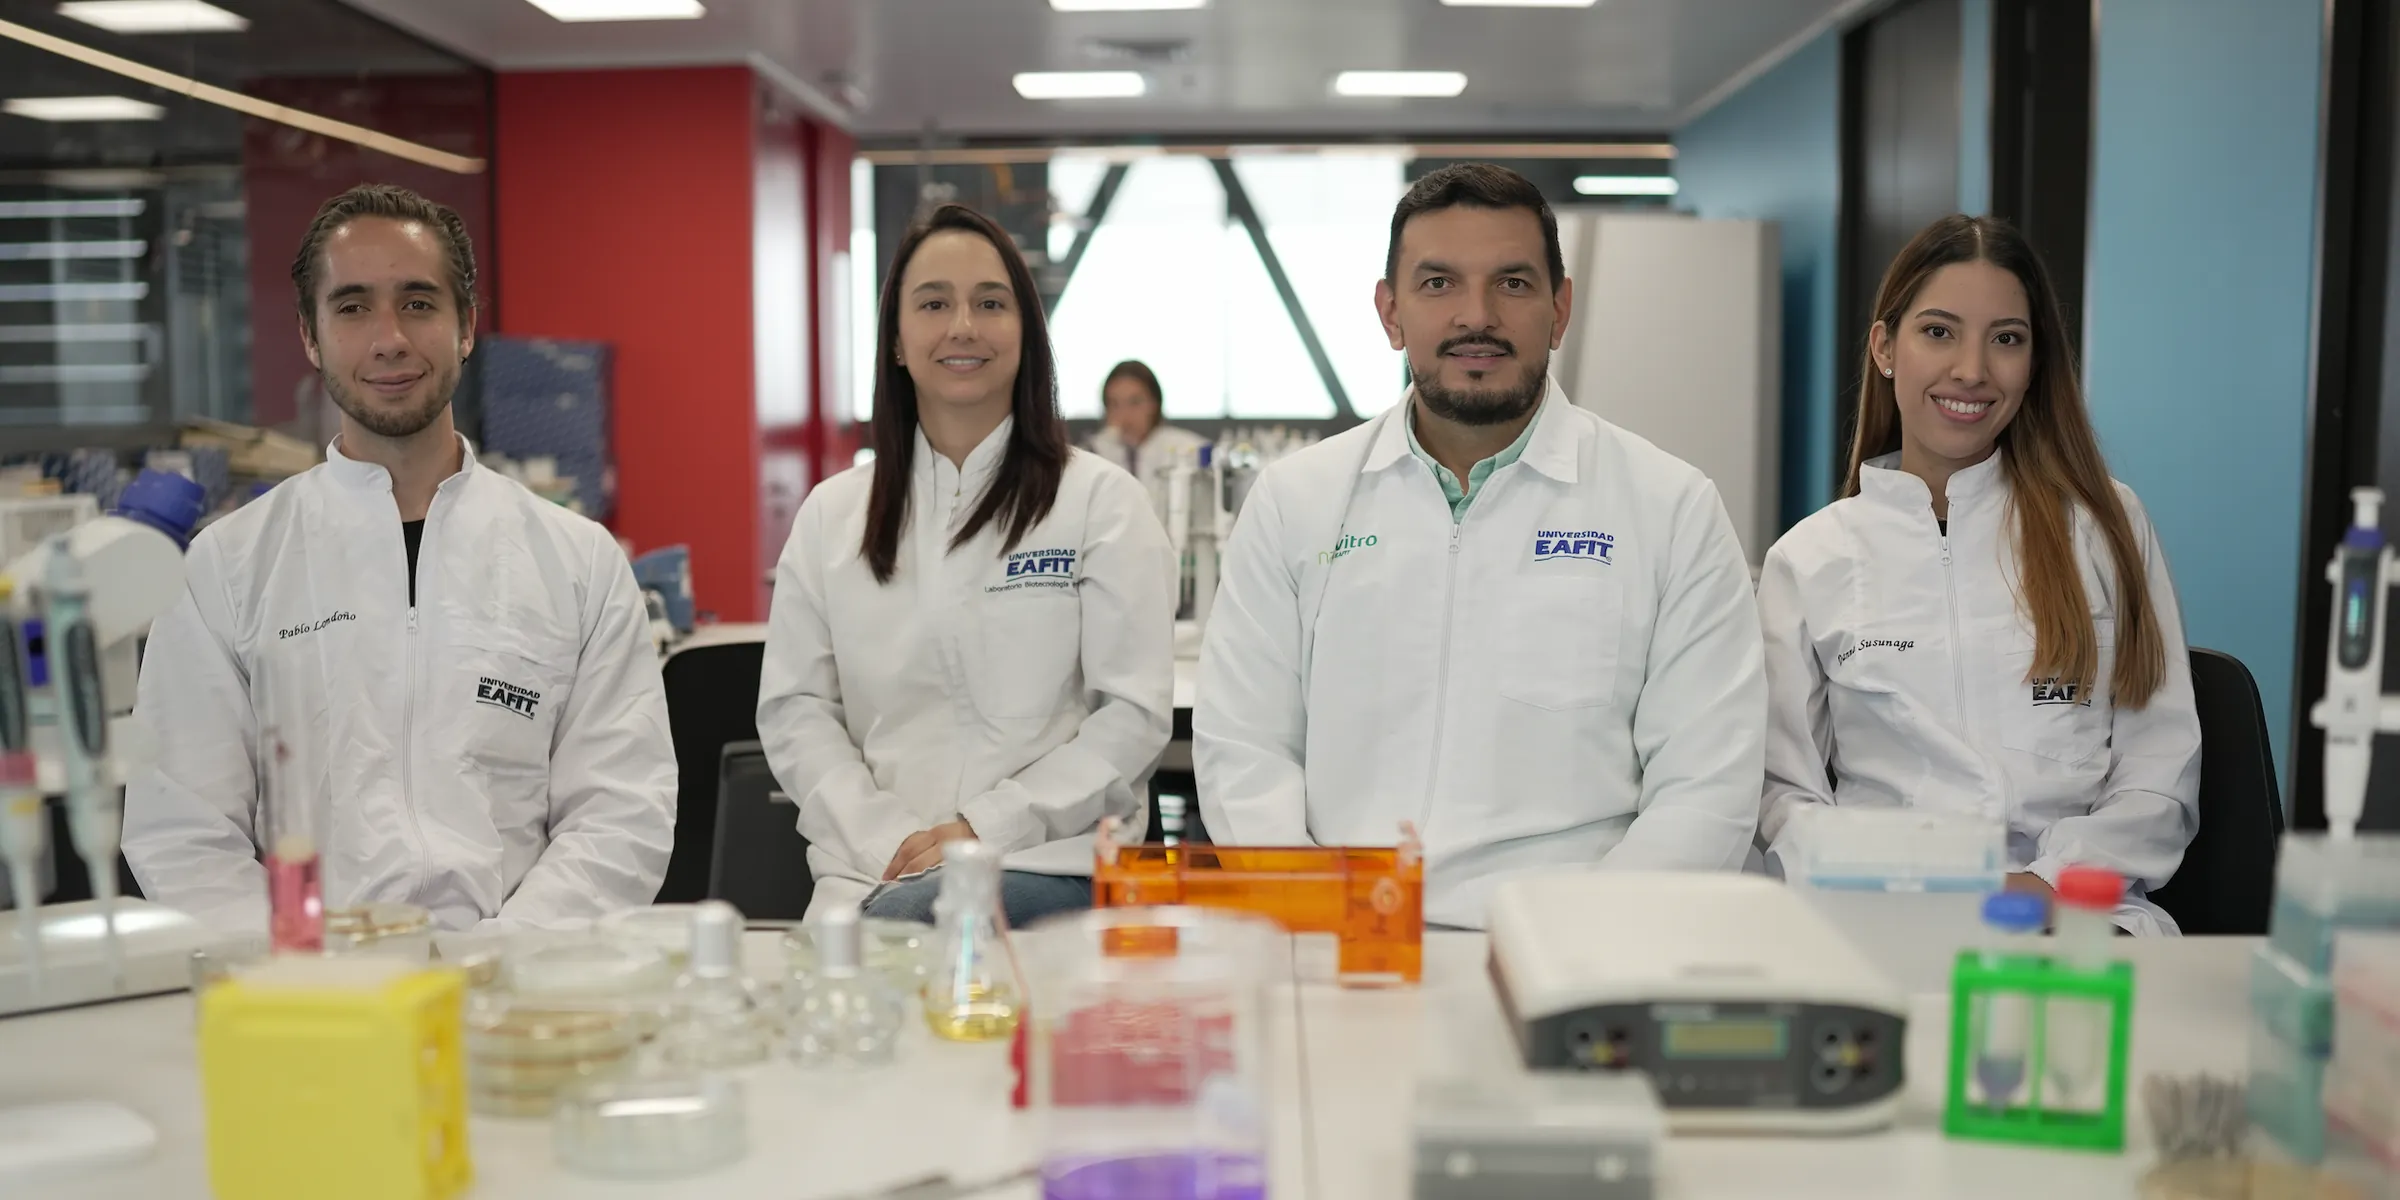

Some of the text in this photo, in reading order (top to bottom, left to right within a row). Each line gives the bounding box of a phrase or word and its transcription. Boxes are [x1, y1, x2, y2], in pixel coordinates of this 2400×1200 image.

[1537, 530, 1614, 542] UNIVERSIDAD
[1008, 548, 1077, 562] UNIVERSIDAD
[1535, 540, 1613, 557] EAFIT
[1006, 558, 1075, 576] EAFIT
[984, 583, 1022, 593] Laboratorio
[1024, 580, 1069, 589] Biotecnología
[278, 610, 356, 639] Pablo Londoño
[1858, 639, 1914, 652] Susunaga
[480, 676, 541, 699] UNIVERSIDAD
[2032, 685, 2080, 701] EAF
[477, 683, 539, 713] EAFIT
